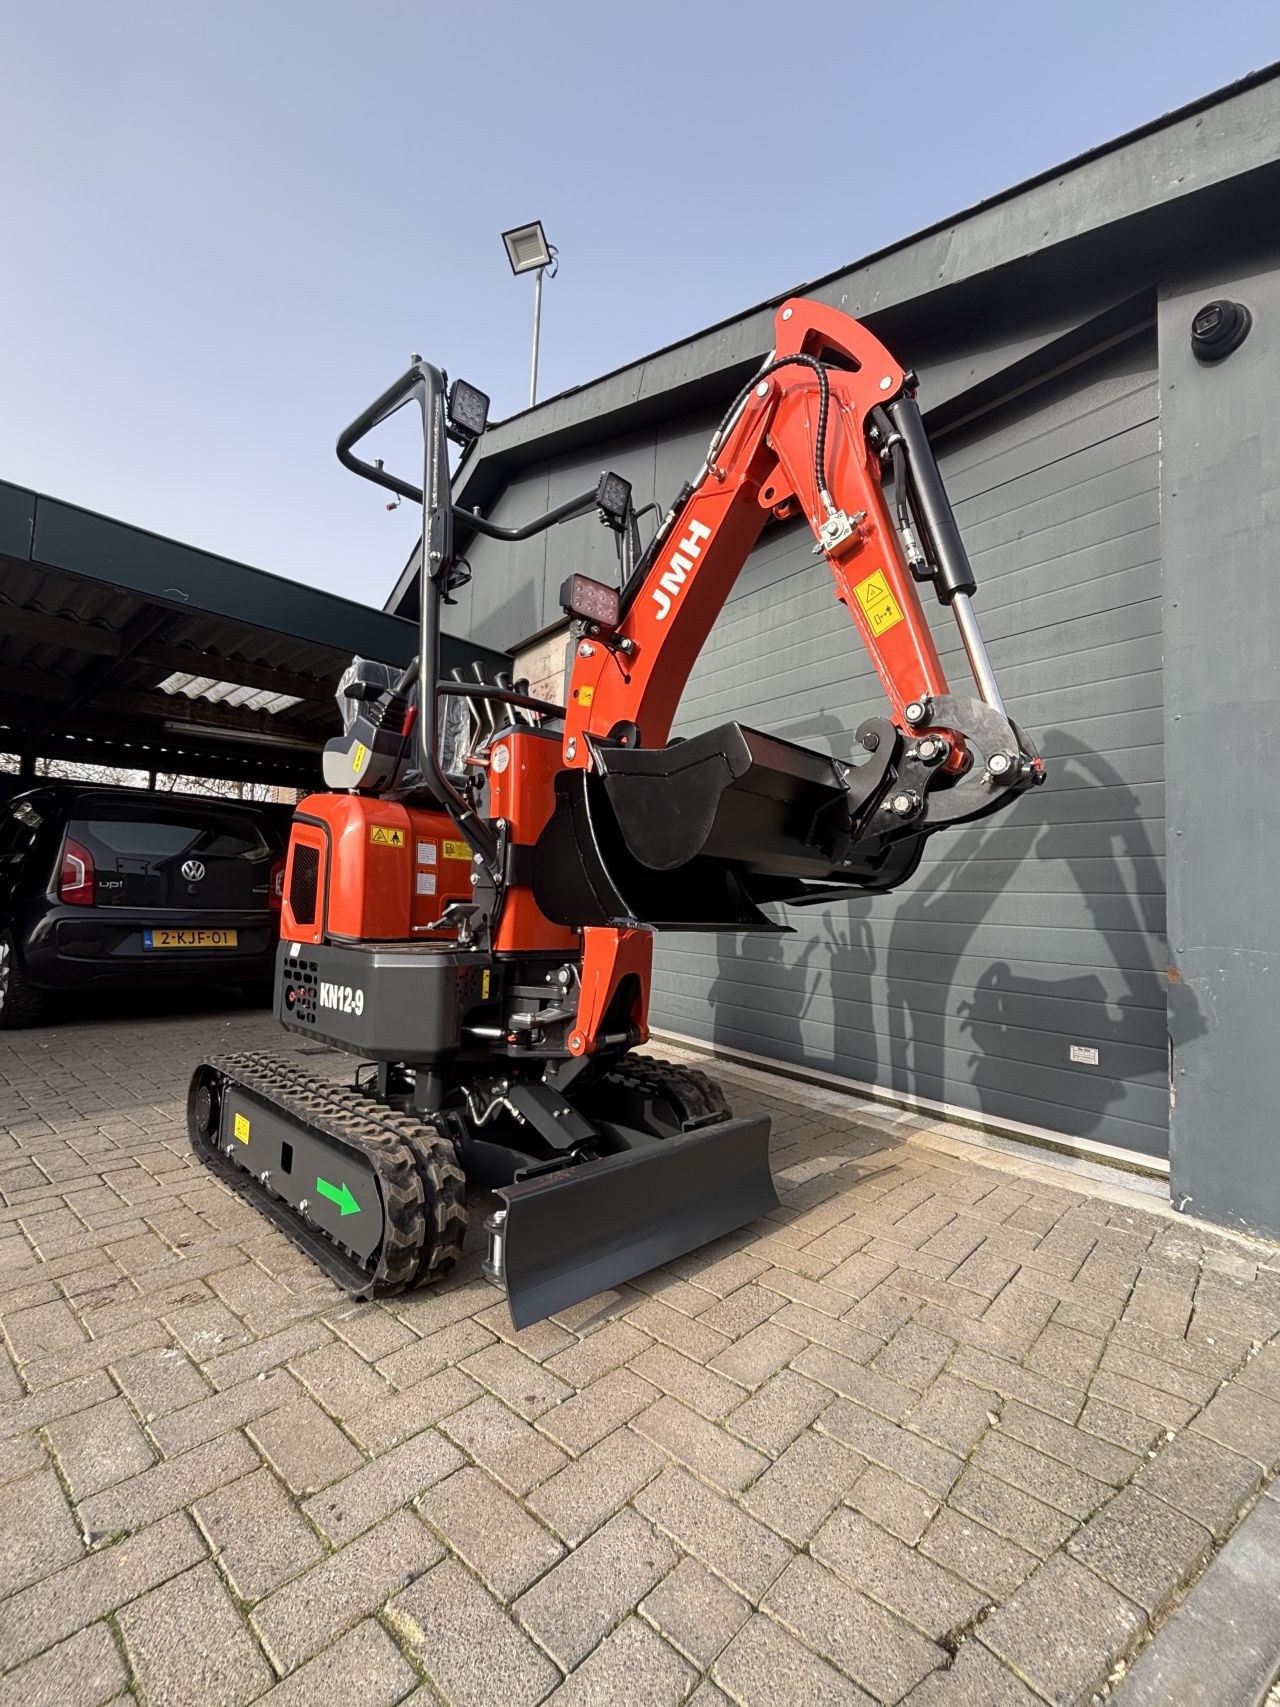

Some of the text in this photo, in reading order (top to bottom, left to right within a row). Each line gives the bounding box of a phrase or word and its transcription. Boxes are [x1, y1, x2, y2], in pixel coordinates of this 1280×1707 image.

[651, 518, 712, 620] JMH
[99, 880, 124, 889] up!
[160, 931, 228, 945] 2-KJF-01
[319, 982, 364, 1016] KN12-9
